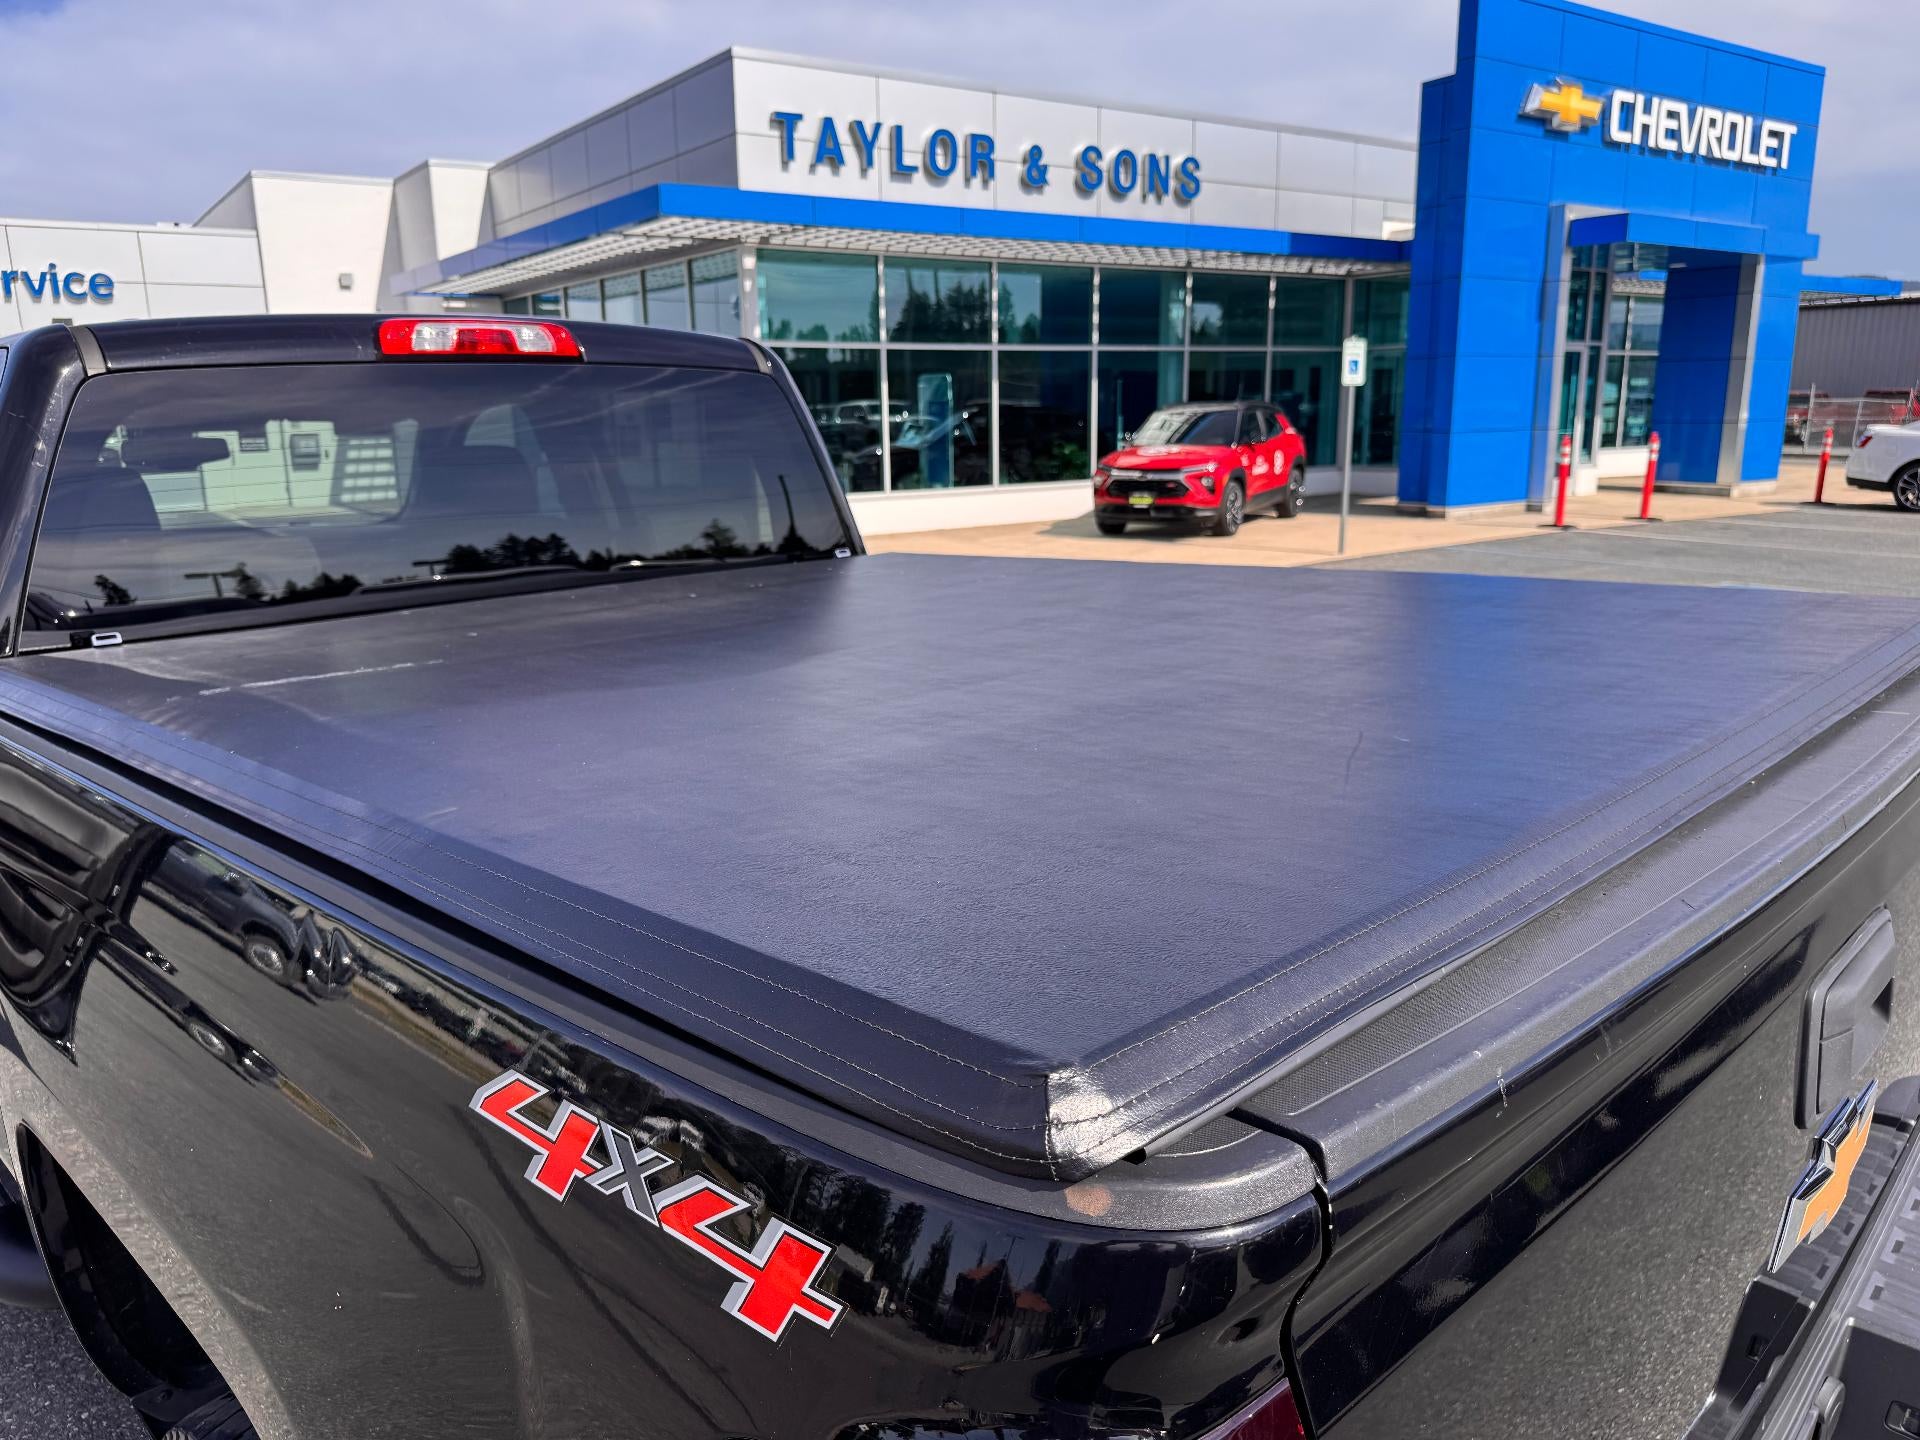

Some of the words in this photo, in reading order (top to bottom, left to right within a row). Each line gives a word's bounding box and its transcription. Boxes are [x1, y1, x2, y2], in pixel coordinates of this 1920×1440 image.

[771, 111, 995, 188] TAYLOR
[1020, 144, 1049, 193] &
[1076, 145, 1201, 206] SONS
[1609, 89, 1798, 170] CHEVROLET
[0, 262, 115, 303] rvice
